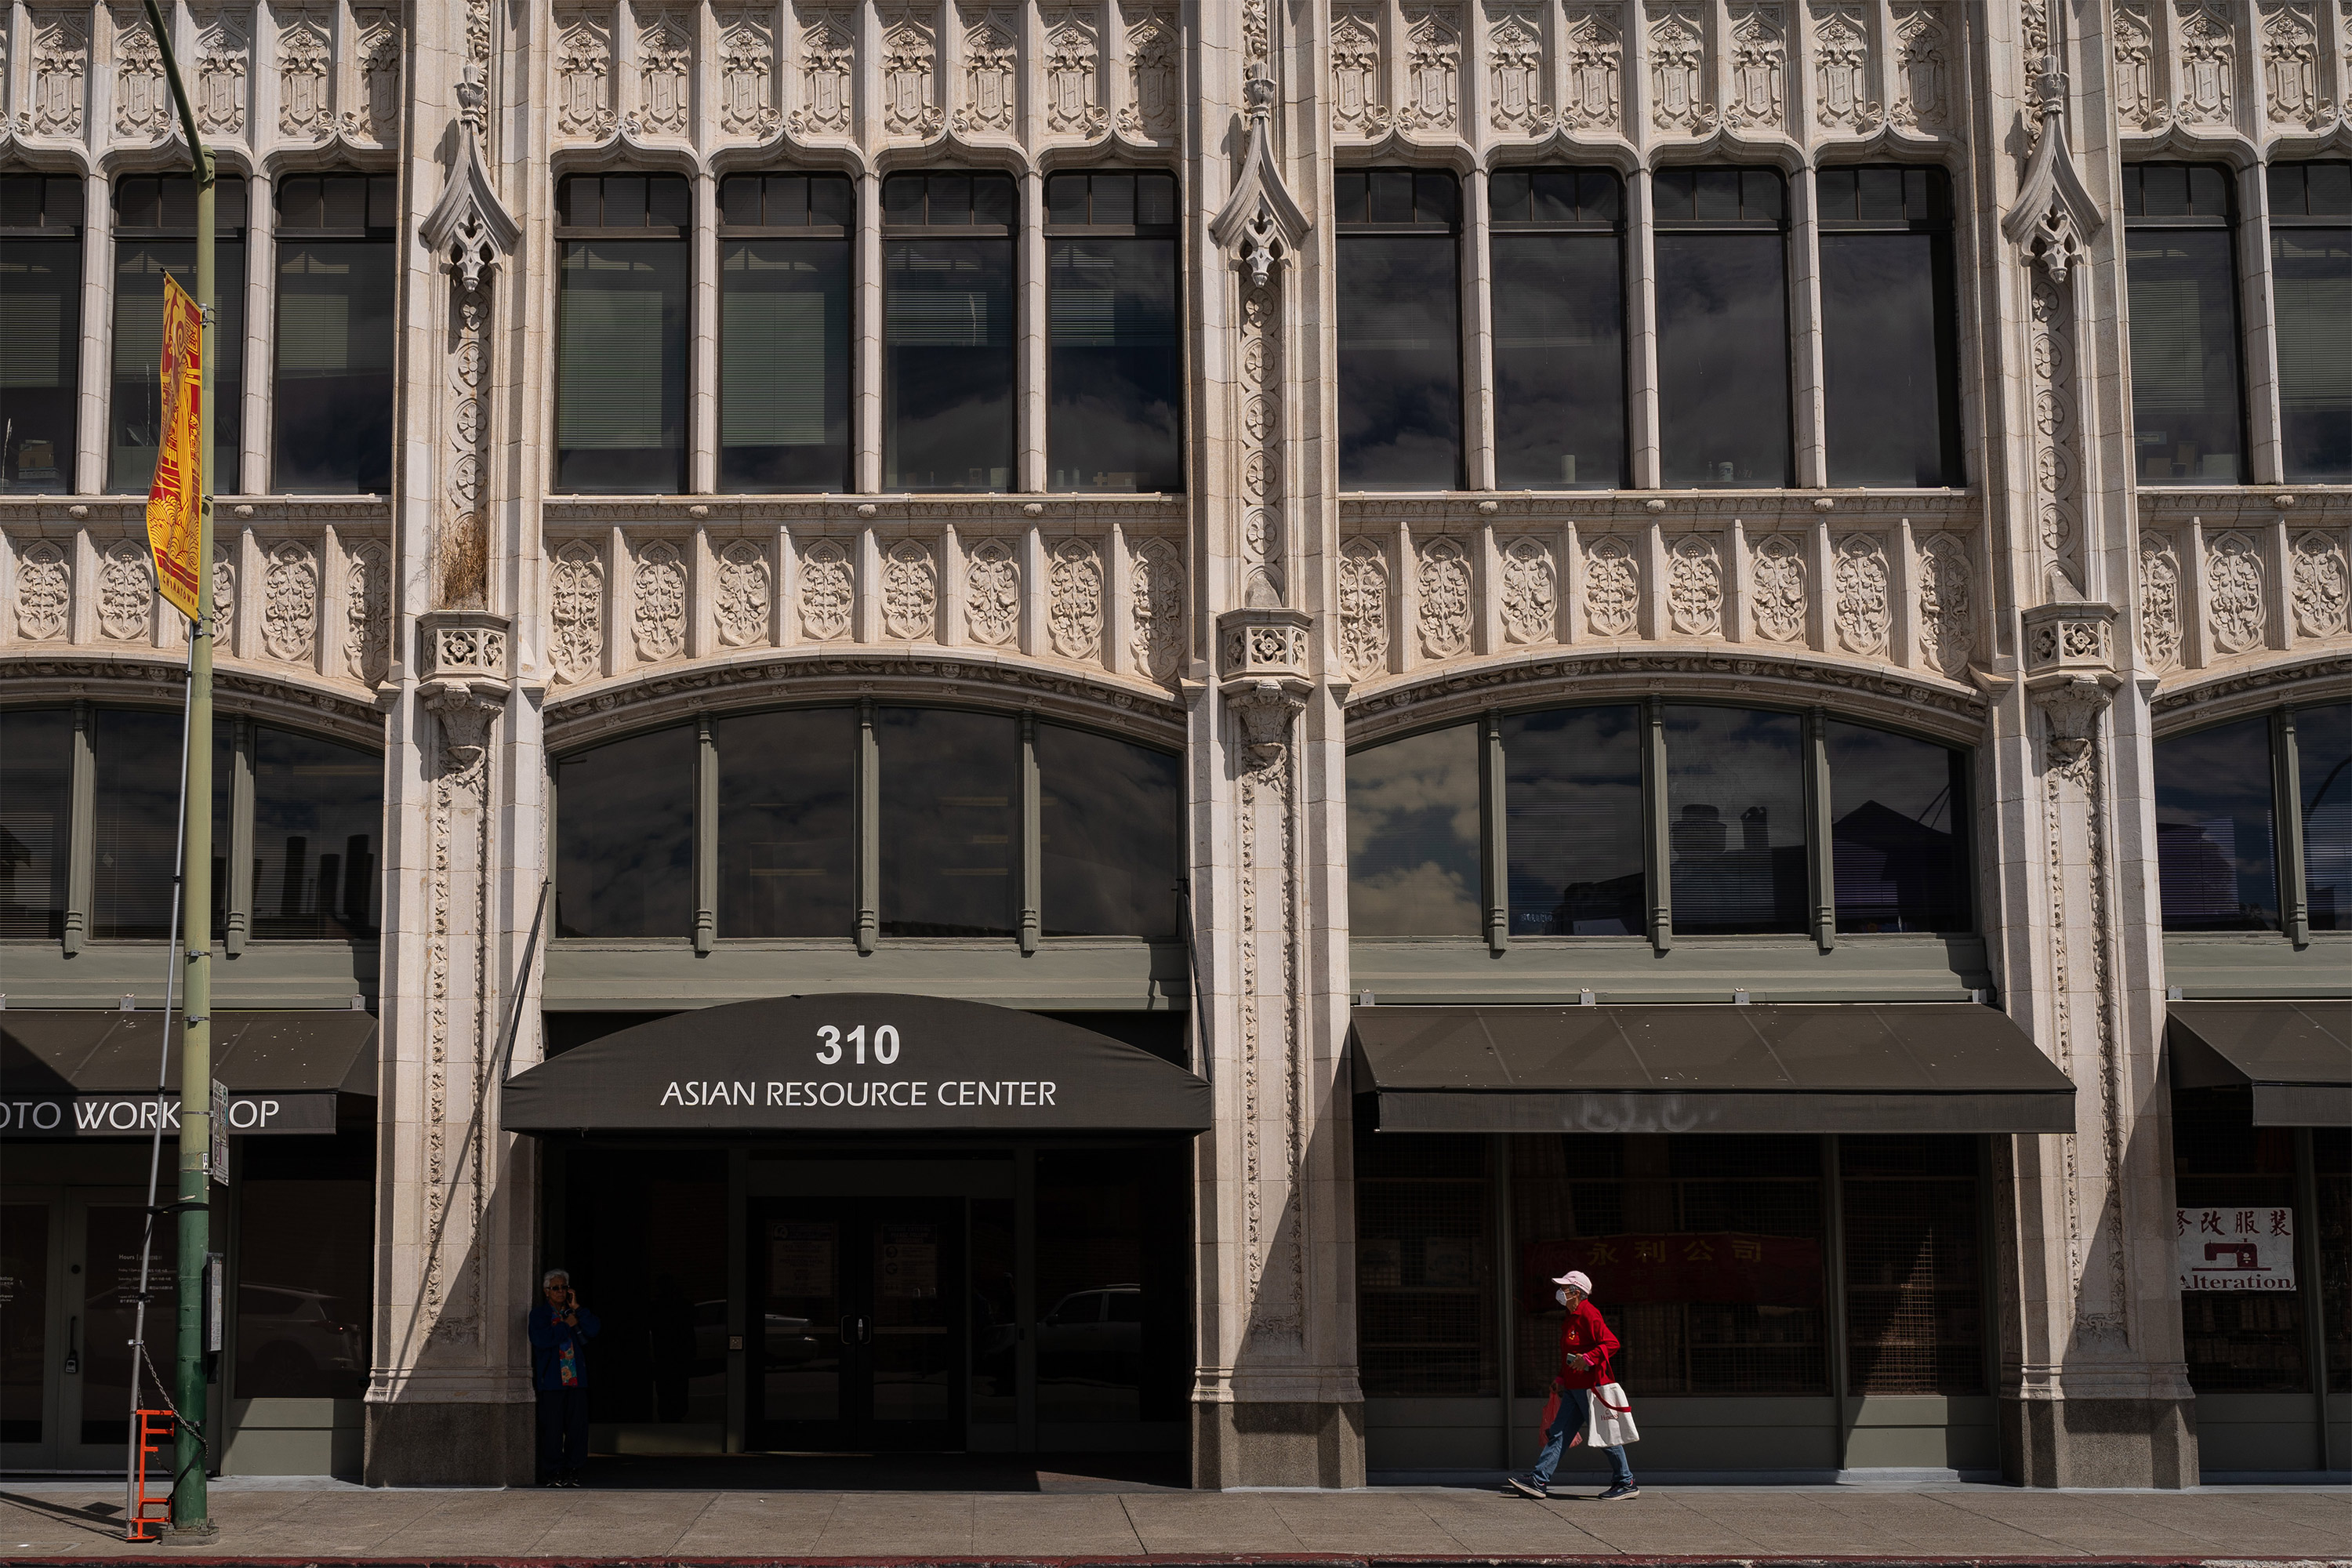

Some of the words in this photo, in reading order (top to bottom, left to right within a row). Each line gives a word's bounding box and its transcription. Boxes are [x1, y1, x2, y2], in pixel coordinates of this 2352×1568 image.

[162, 575, 195, 607] CHINATOWN
[815, 1024, 901, 1065] 310
[660, 1081, 756, 1106] ASIAN
[766, 1081, 927, 1106] RESOURCE
[937, 1081, 1057, 1106] CENTER
[72, 1100, 280, 1130] WORKOP
[1587, 1239, 1762, 1266] 永利公司
[2180, 1274, 2291, 1290] Alteration
